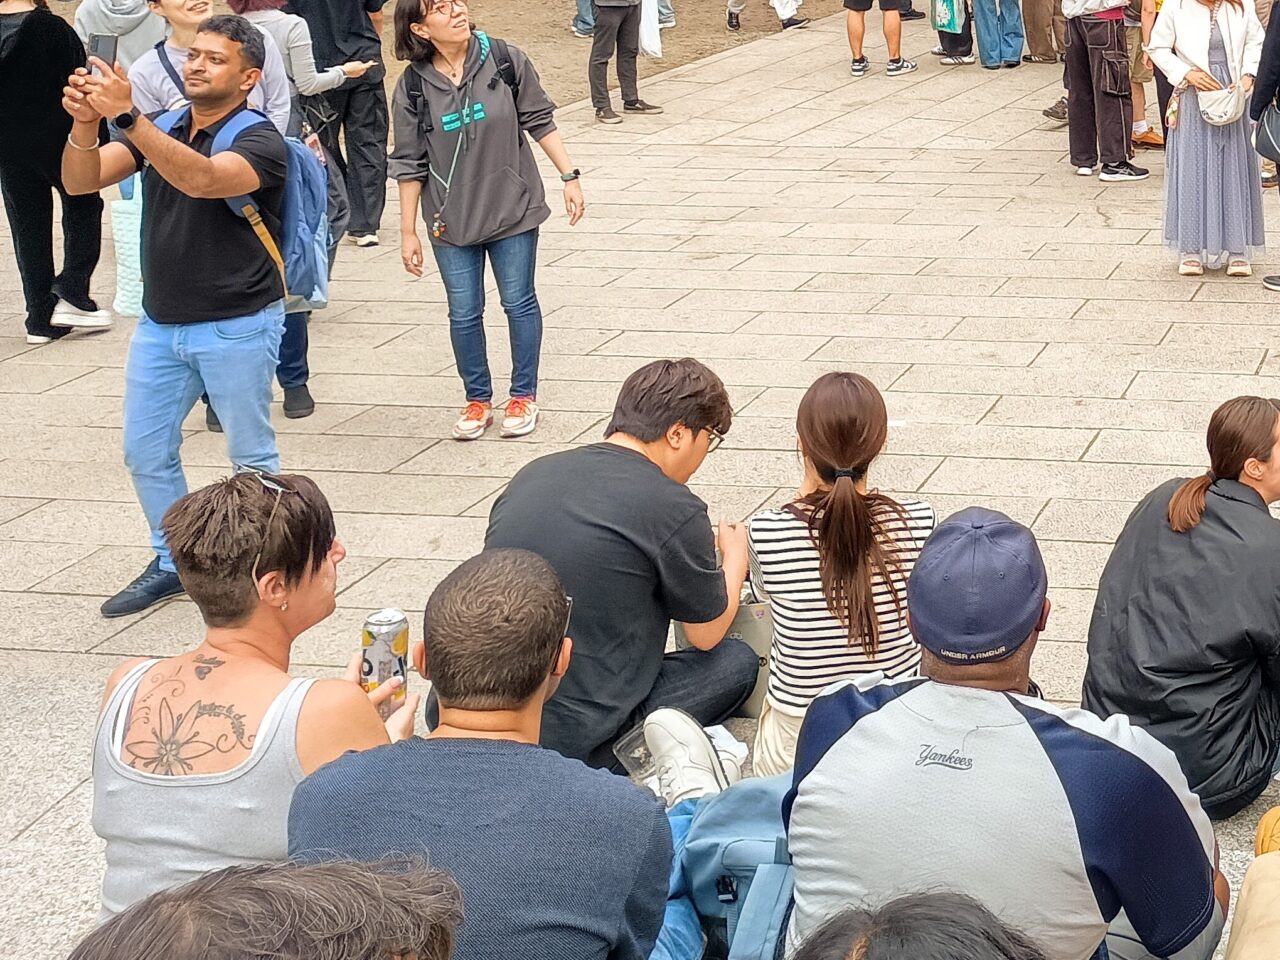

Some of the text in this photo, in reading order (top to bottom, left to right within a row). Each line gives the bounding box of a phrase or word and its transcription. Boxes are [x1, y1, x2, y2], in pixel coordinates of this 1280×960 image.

[941, 646, 1005, 659] UNDER ARMOUR
[915, 744, 973, 769] Yankees
